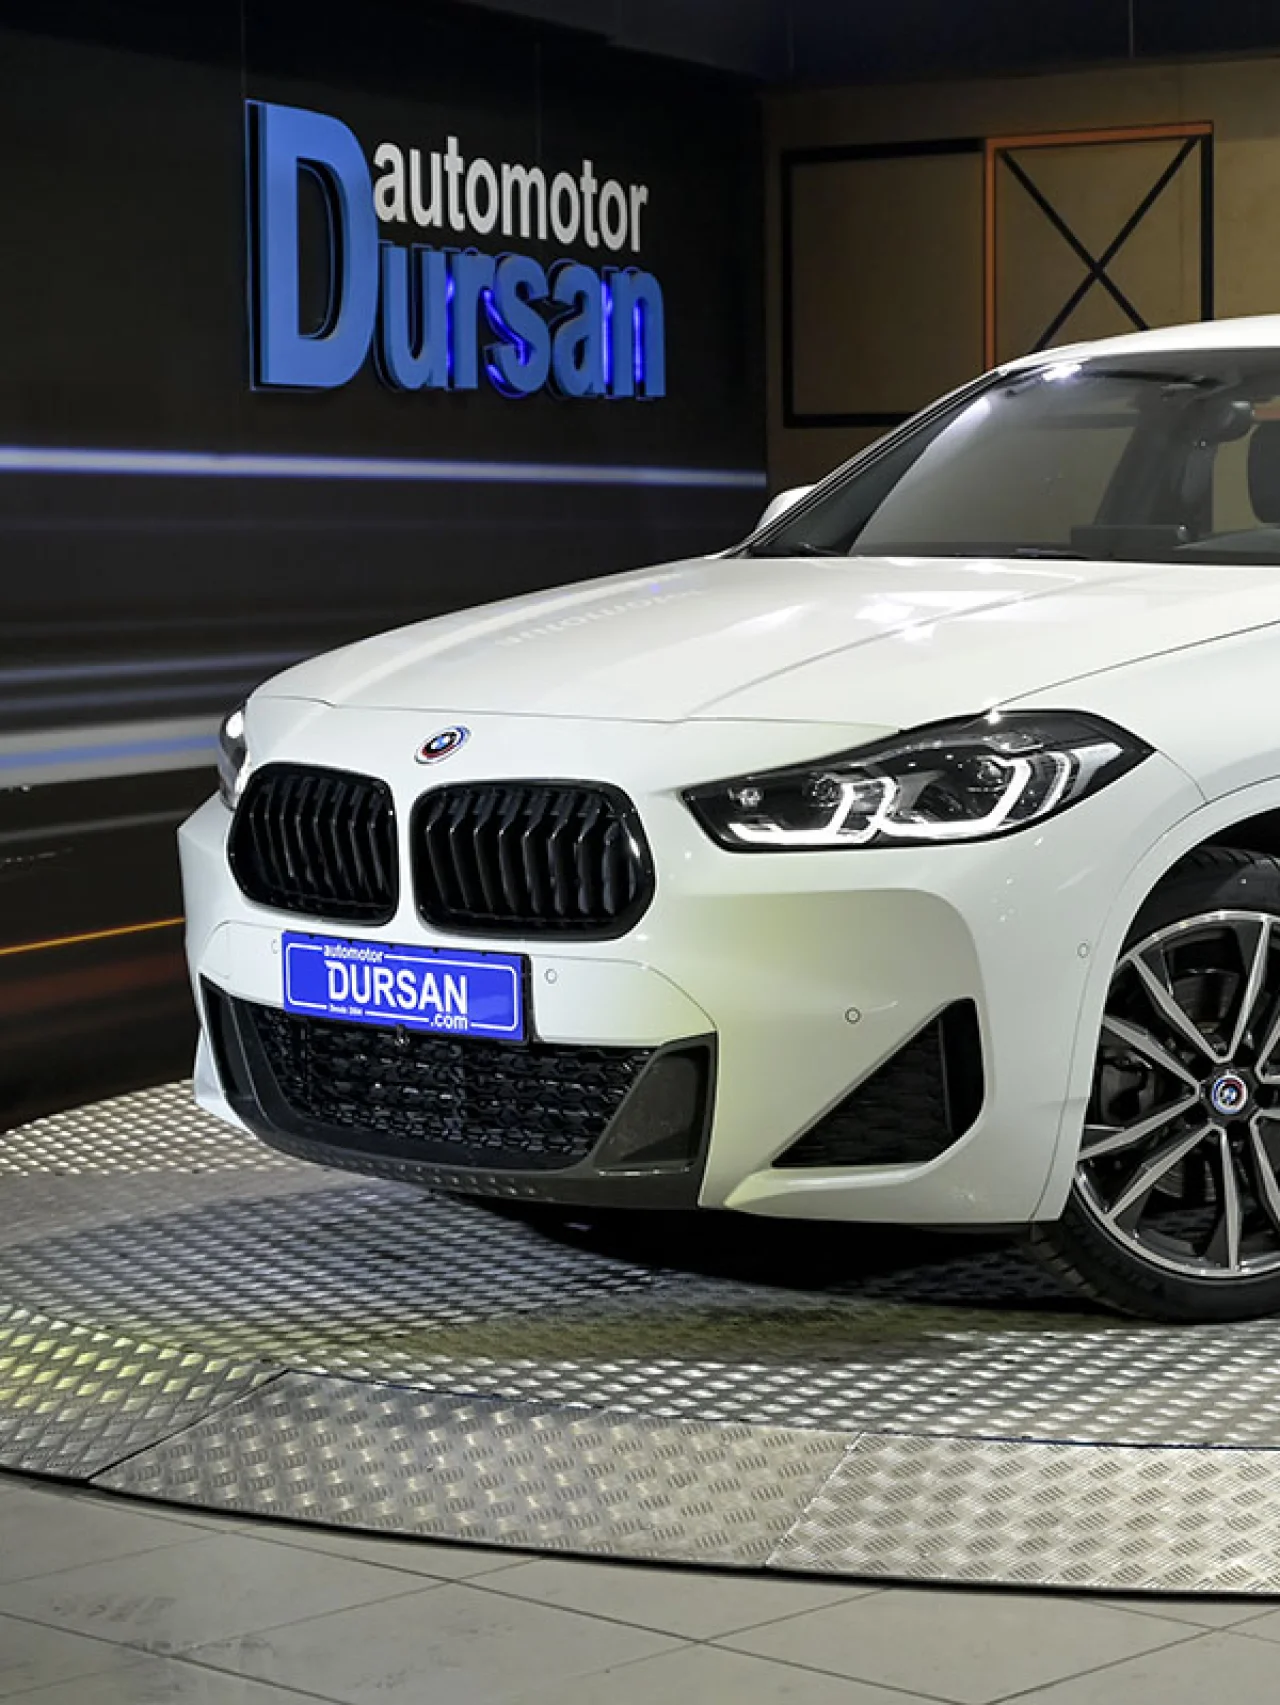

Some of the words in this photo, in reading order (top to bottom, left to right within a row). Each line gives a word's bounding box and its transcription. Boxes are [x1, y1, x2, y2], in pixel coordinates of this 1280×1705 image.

[373, 136, 649, 252] automotor
[246, 99, 666, 399] Dursan
[323, 944, 384, 963] automotor
[324, 959, 468, 1014] DURSAN
[430, 1012, 468, 1031] .com
